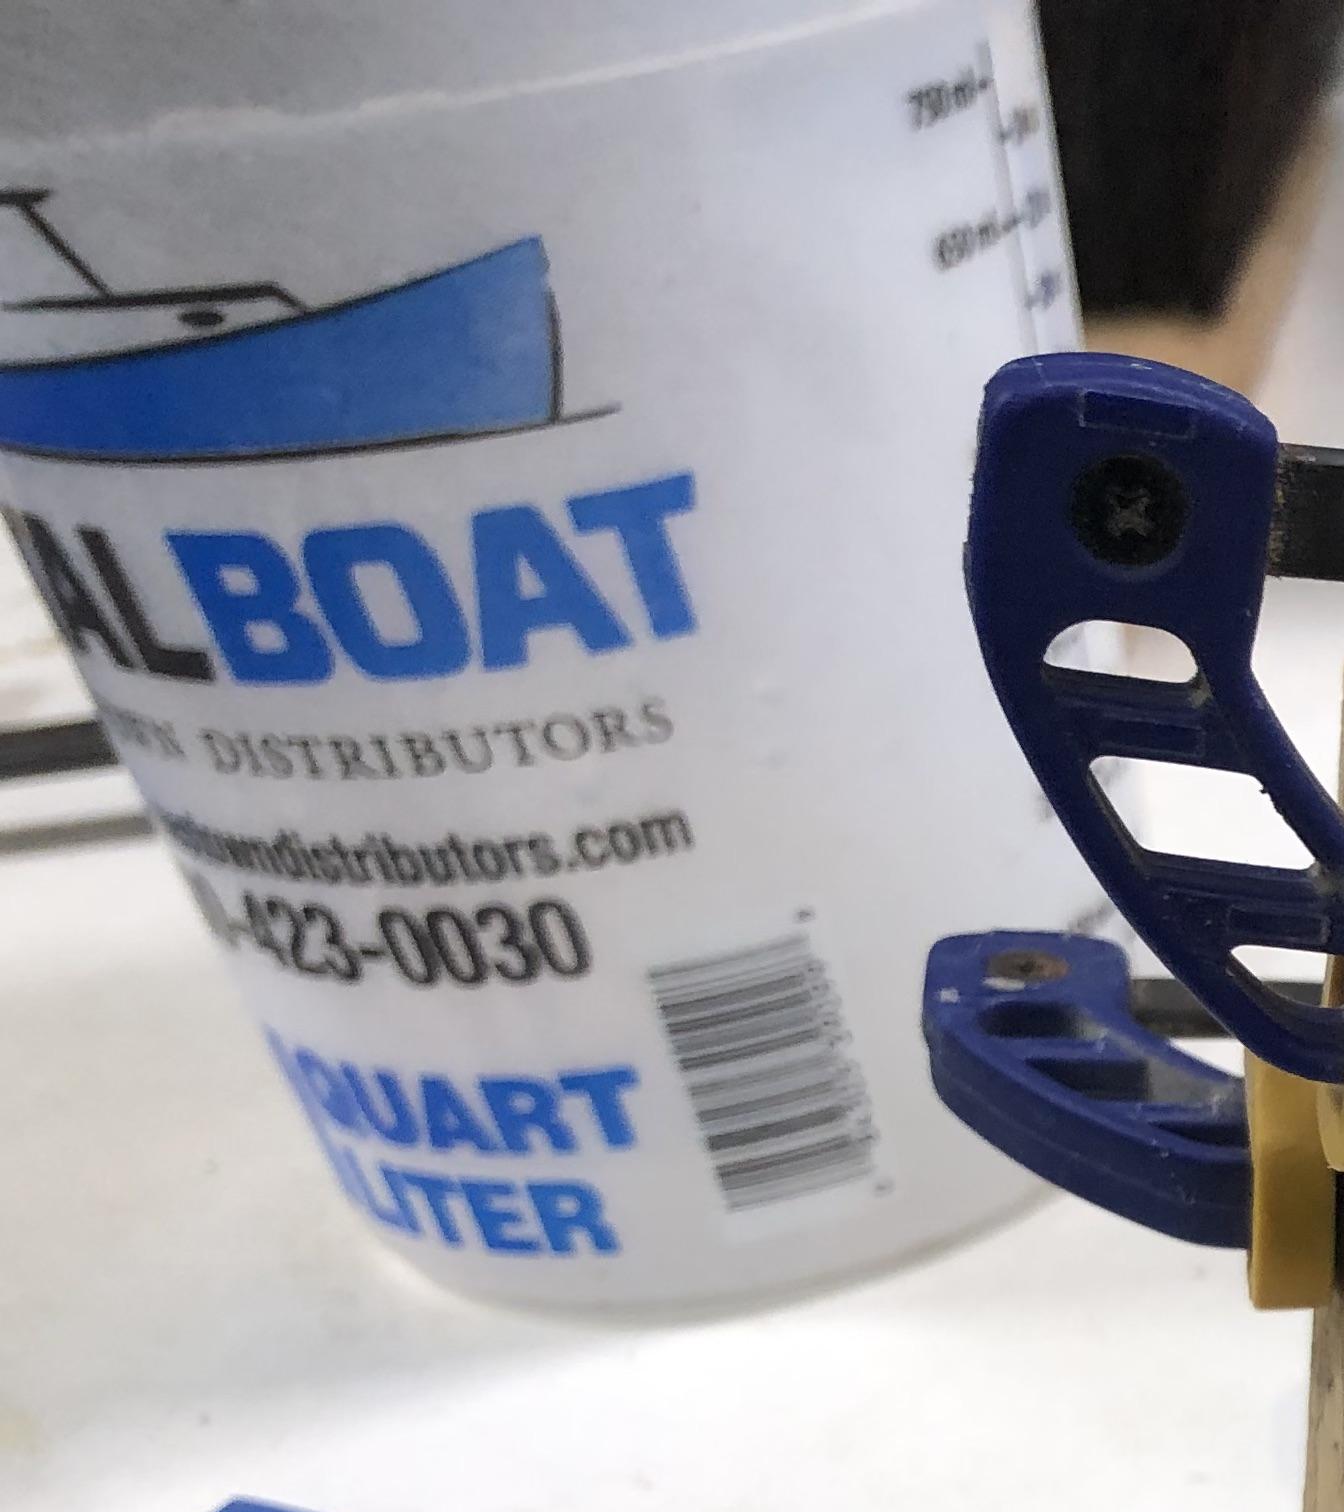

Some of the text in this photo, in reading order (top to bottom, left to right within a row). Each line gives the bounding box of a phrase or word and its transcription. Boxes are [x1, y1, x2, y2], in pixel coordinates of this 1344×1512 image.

[4, 470, 697, 687] ALBOAT
[199, 697, 675, 781] DISTRIBUTORS
[296, 1045, 641, 1158] QUART
